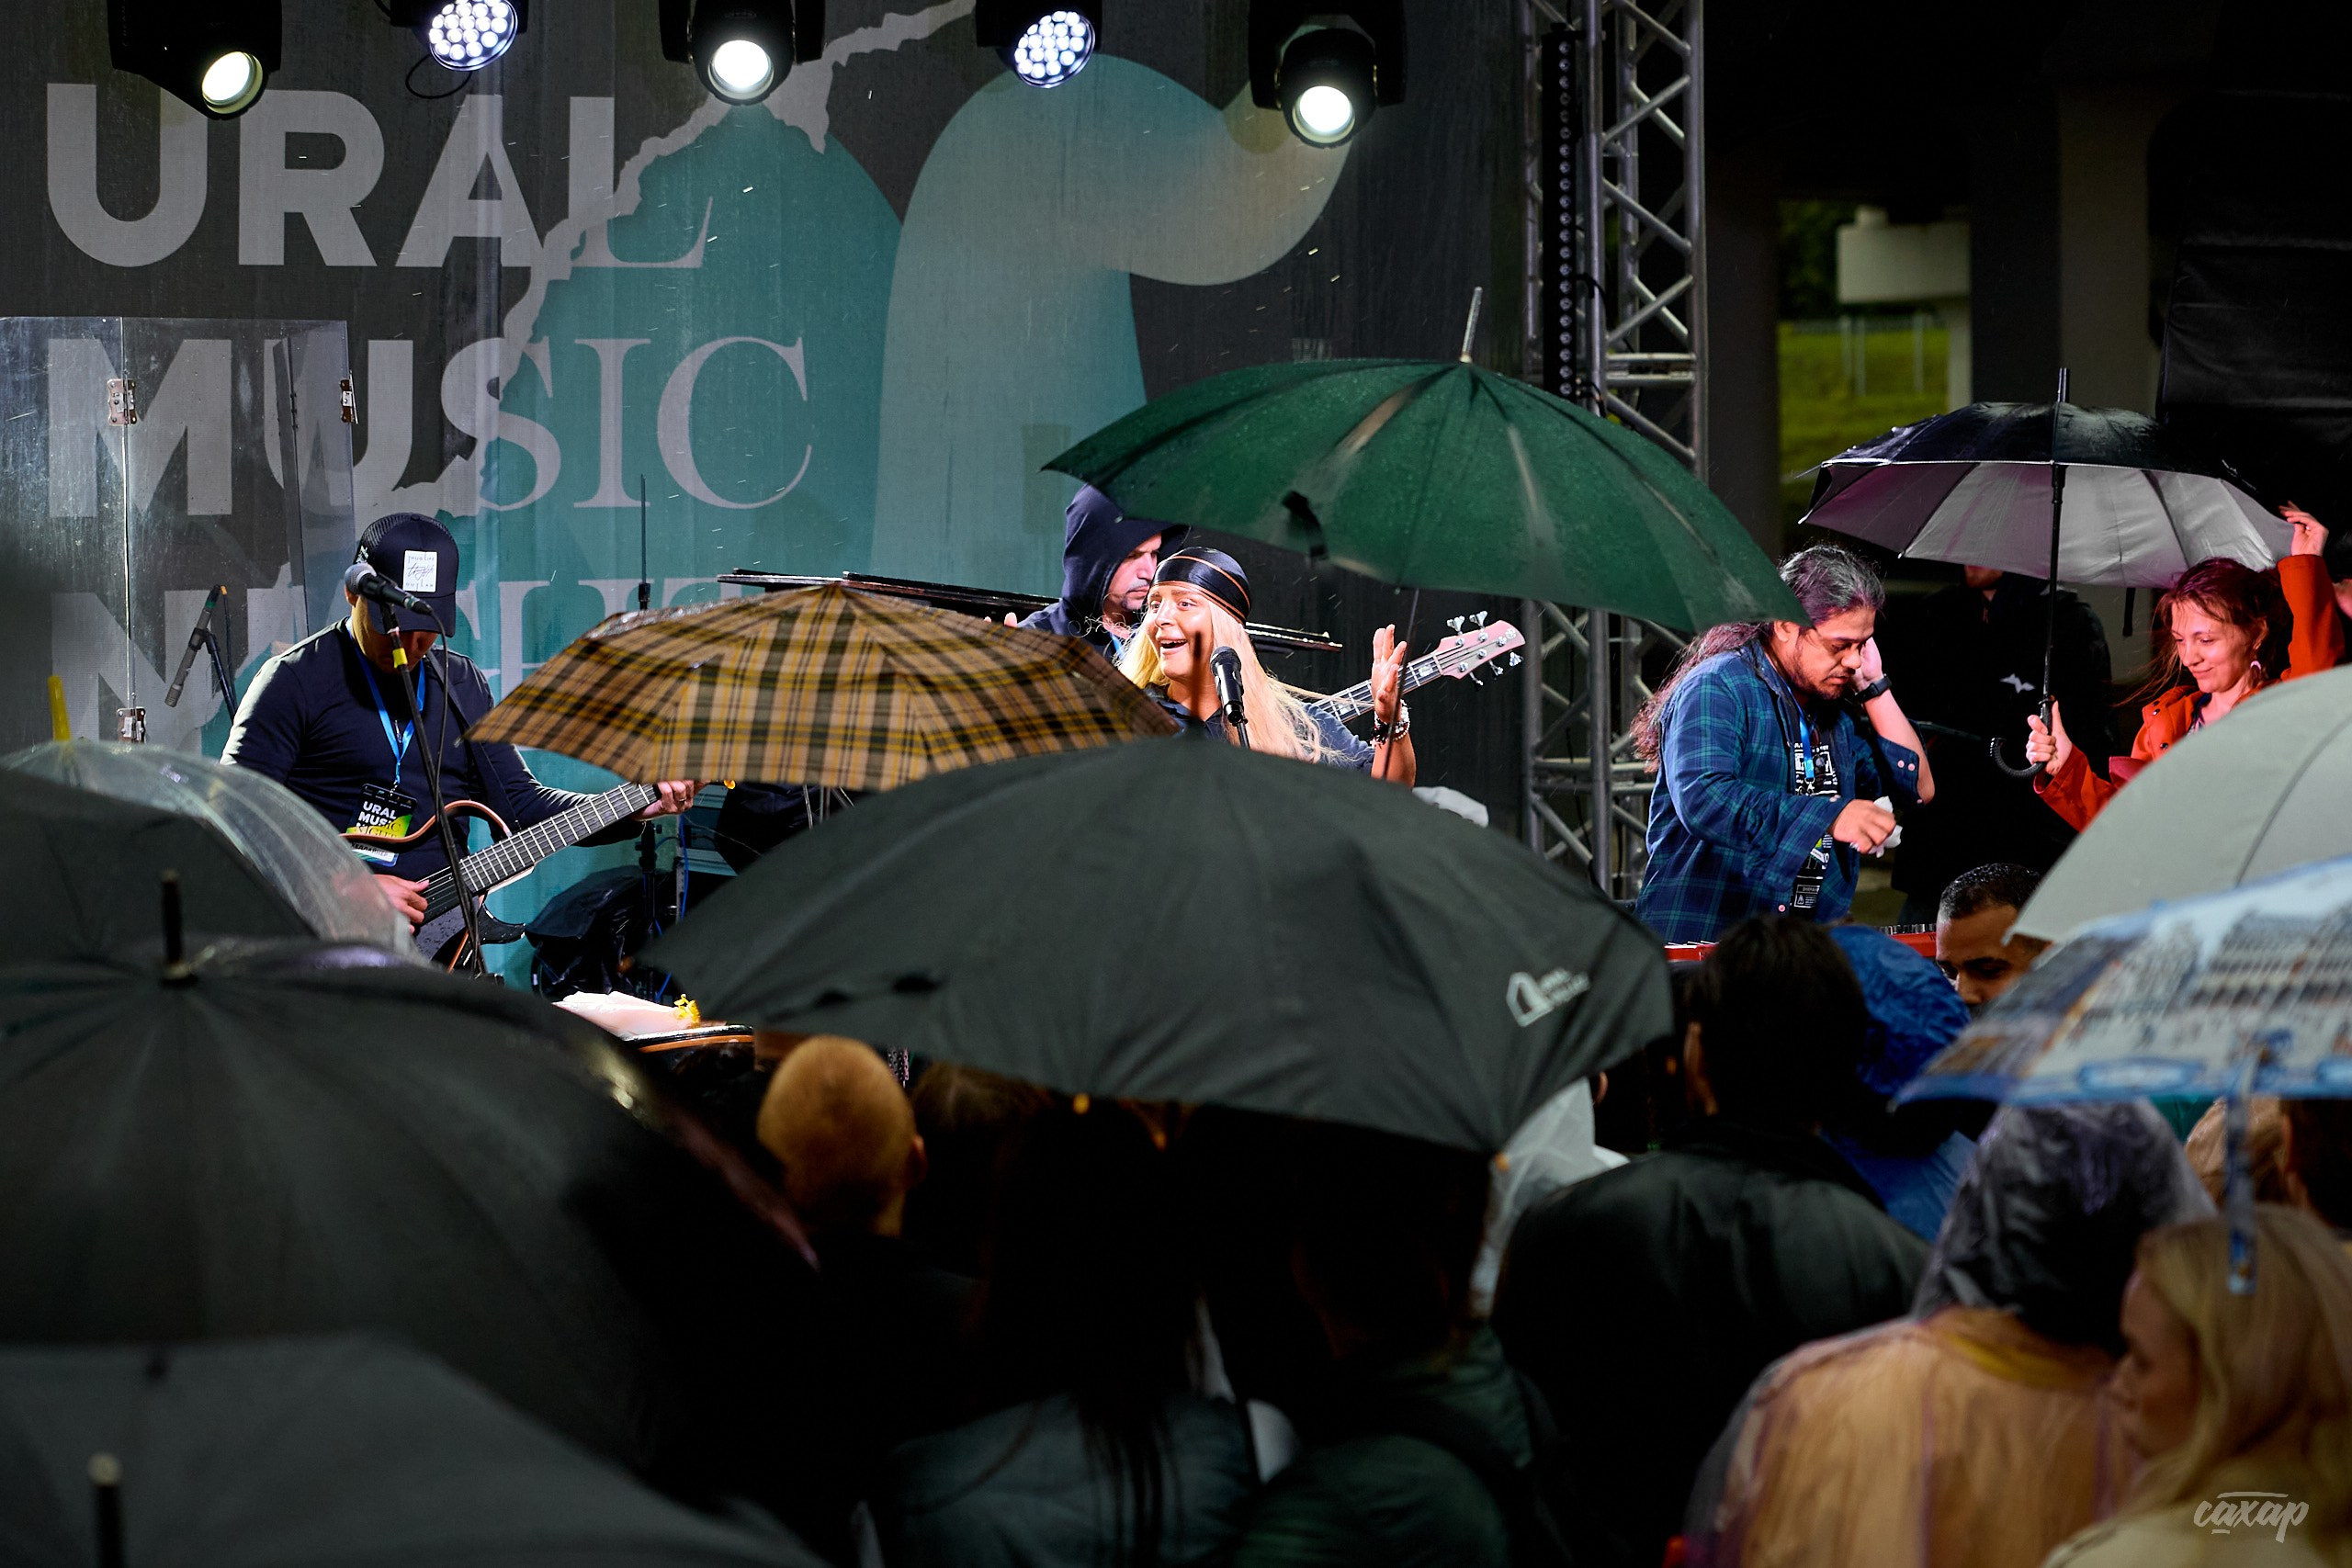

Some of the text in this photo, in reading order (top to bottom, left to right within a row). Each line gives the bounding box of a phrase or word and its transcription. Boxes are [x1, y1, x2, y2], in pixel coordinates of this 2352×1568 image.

[47, 83, 715, 268] URAL
[49, 337, 813, 518] MUSIC
[358, 811, 401, 832] MUSIC
[363, 800, 397, 820] URAL
